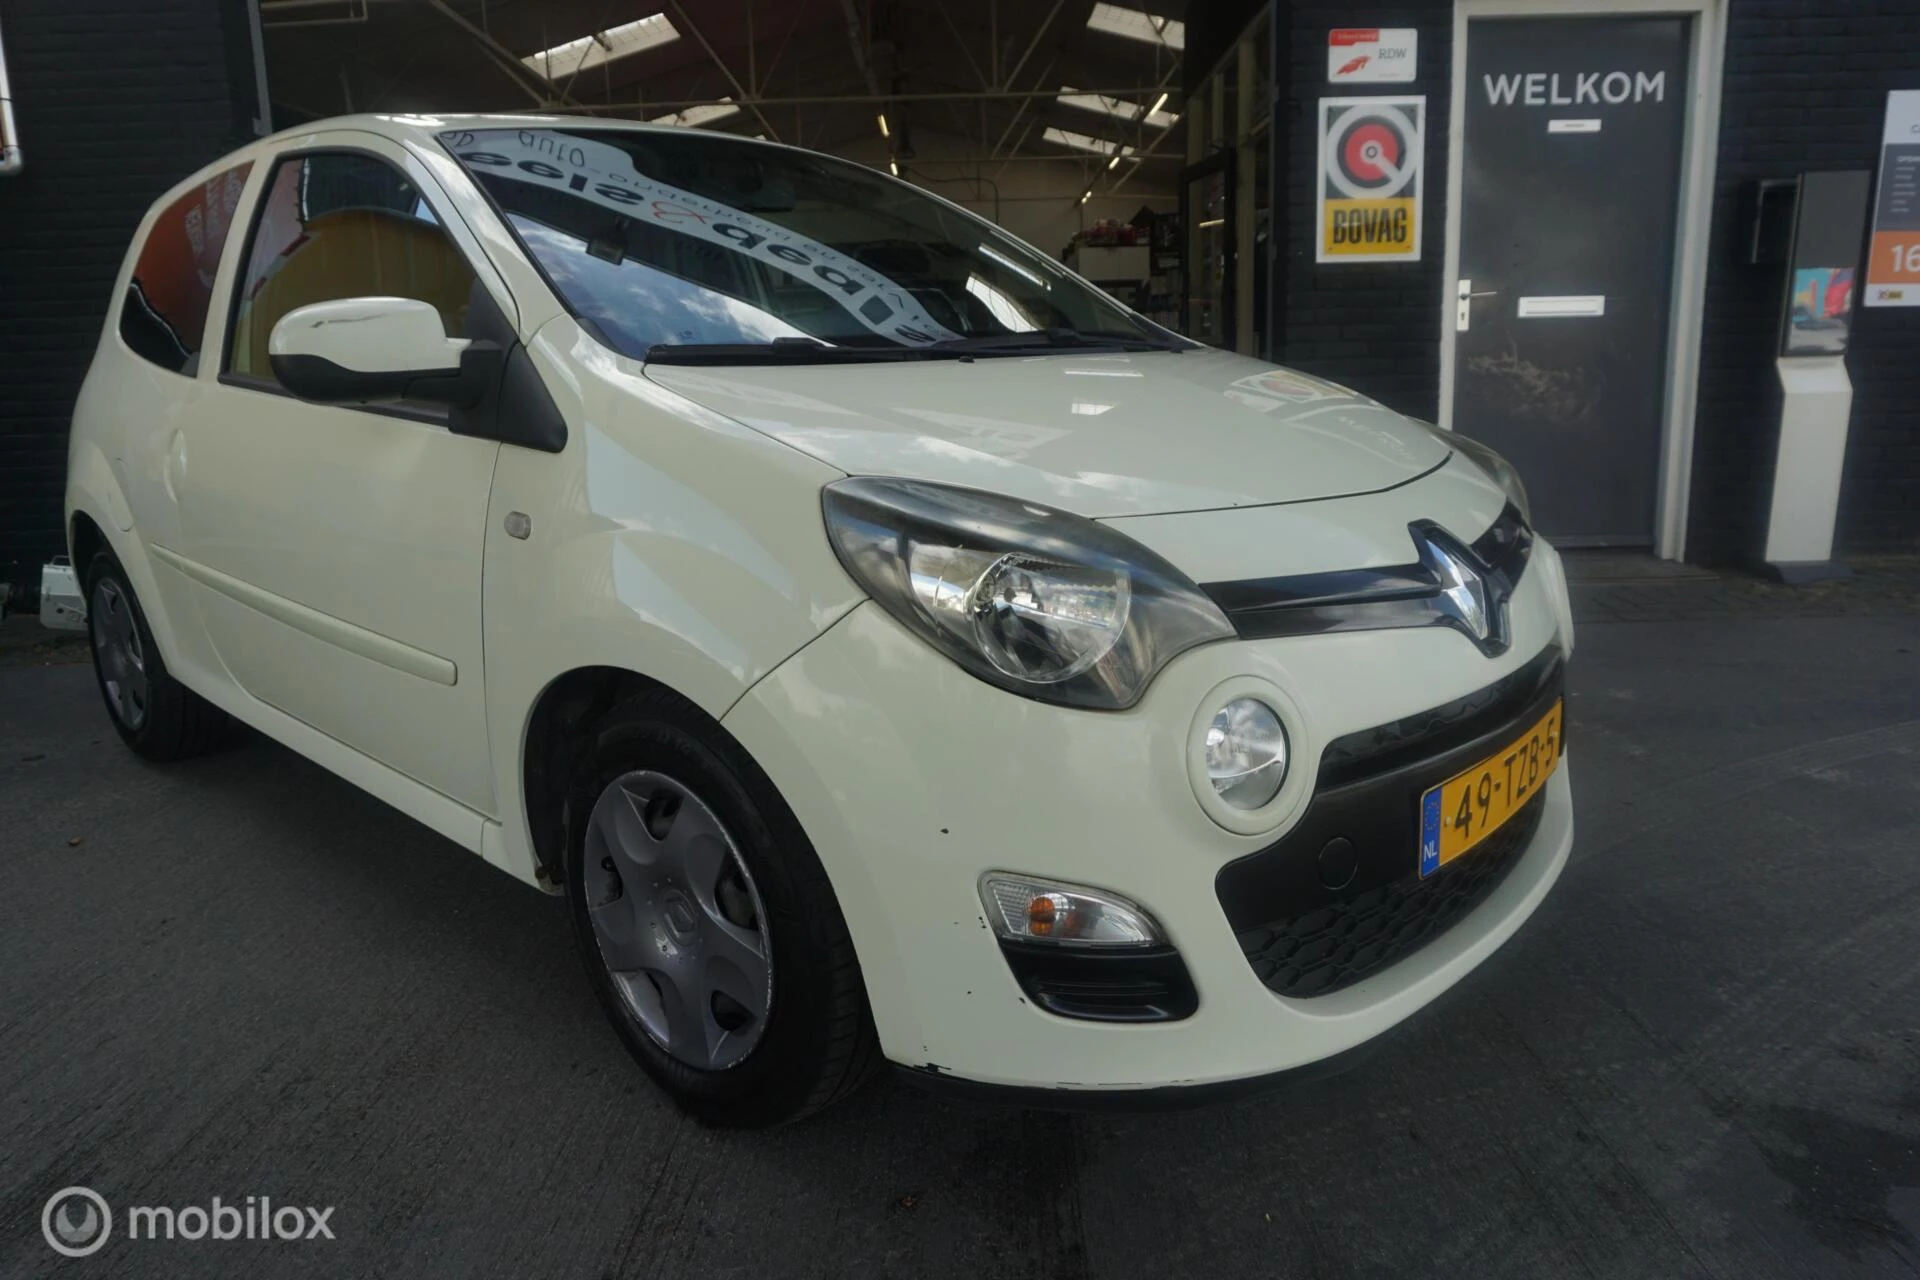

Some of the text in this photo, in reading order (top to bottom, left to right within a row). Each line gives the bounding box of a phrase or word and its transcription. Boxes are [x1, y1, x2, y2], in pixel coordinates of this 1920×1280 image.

[1378, 48, 1407, 60] RDW
[1484, 71, 1666, 106] WELKOM
[1333, 207, 1407, 244] BOVAG
[1454, 717, 1556, 840] 49-TZB-5
[1423, 840, 1438, 863] NL
